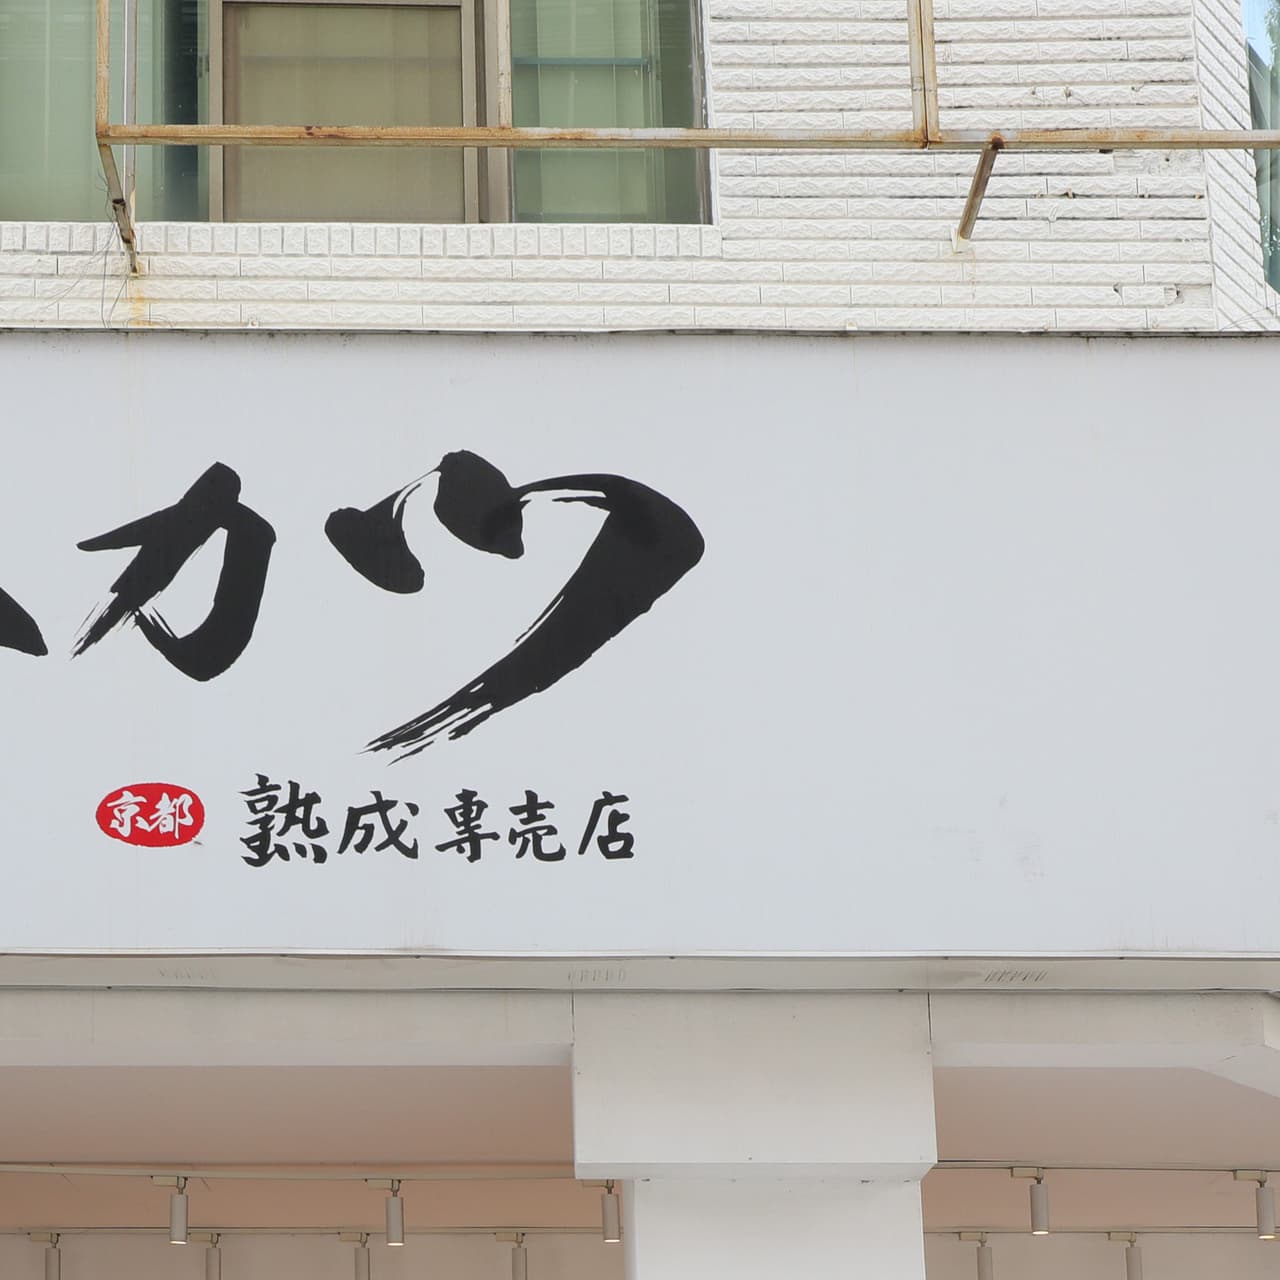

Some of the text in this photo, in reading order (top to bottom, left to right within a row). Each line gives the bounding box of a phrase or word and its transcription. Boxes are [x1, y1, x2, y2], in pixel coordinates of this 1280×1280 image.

[106, 773, 635, 868] 京都 熟成専売店
